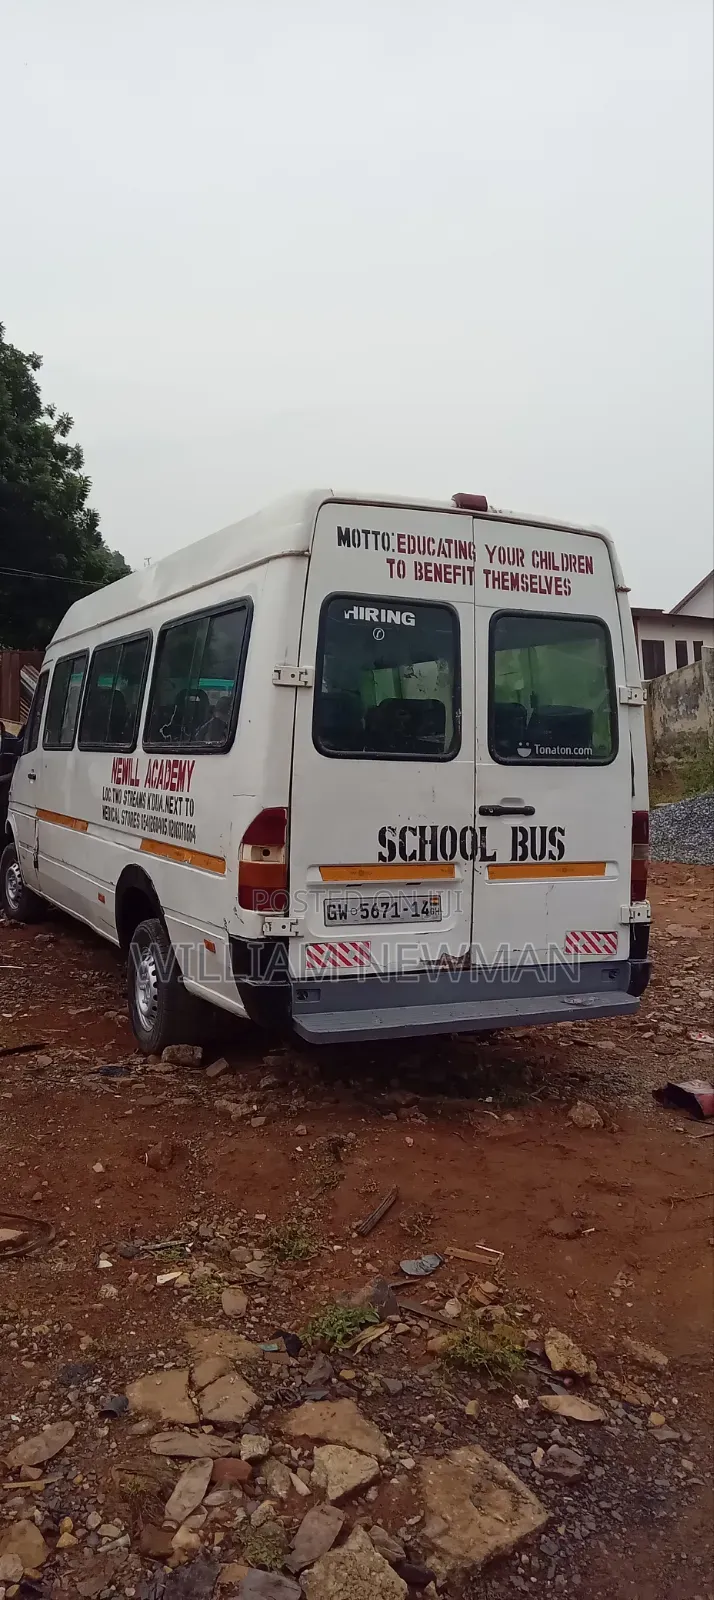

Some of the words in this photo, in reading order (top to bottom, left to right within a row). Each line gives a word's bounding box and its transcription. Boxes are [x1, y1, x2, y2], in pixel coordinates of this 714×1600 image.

[485, 544, 525, 568] YOUR
[532, 550, 594, 575] CHILDREN
[386, 558, 406, 579] TO
[414, 560, 475, 586] BENEFIT
[483, 569, 571, 596] THEMSELVES
[534, 744, 593, 755] Tonaton.com
[111, 757, 140, 787] NEWILL
[144, 759, 195, 792] ACADEMY
[102, 804, 120, 824] MEDICAL
[121, 810, 140, 829] STORES
[185, 797, 195, 817] TO
[378, 825, 497, 862] SCHOOL
[510, 826, 566, 862] BUS
[327, 903, 348, 920] GW
[359, 901, 429, 919] 5671-14
